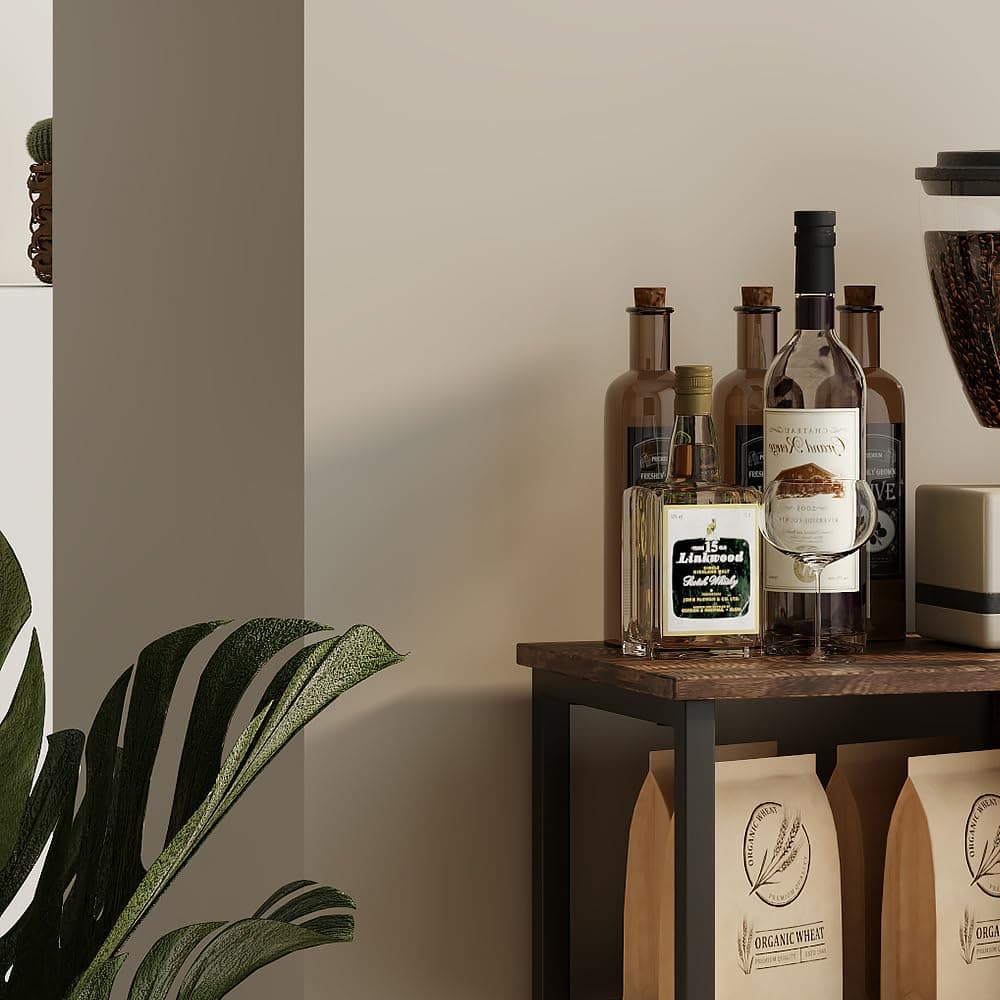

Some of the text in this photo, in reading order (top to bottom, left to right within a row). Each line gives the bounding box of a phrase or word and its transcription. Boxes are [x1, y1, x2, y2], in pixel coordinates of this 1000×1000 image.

[675, 551, 744, 564] Linkwood
[704, 540, 718, 553] 15
[748, 806, 778, 866] ORGANIC WHEAT
[969, 798, 998, 858] ORGANIC WHEAT
[754, 926, 825, 950] ORGANIC WHEAT
